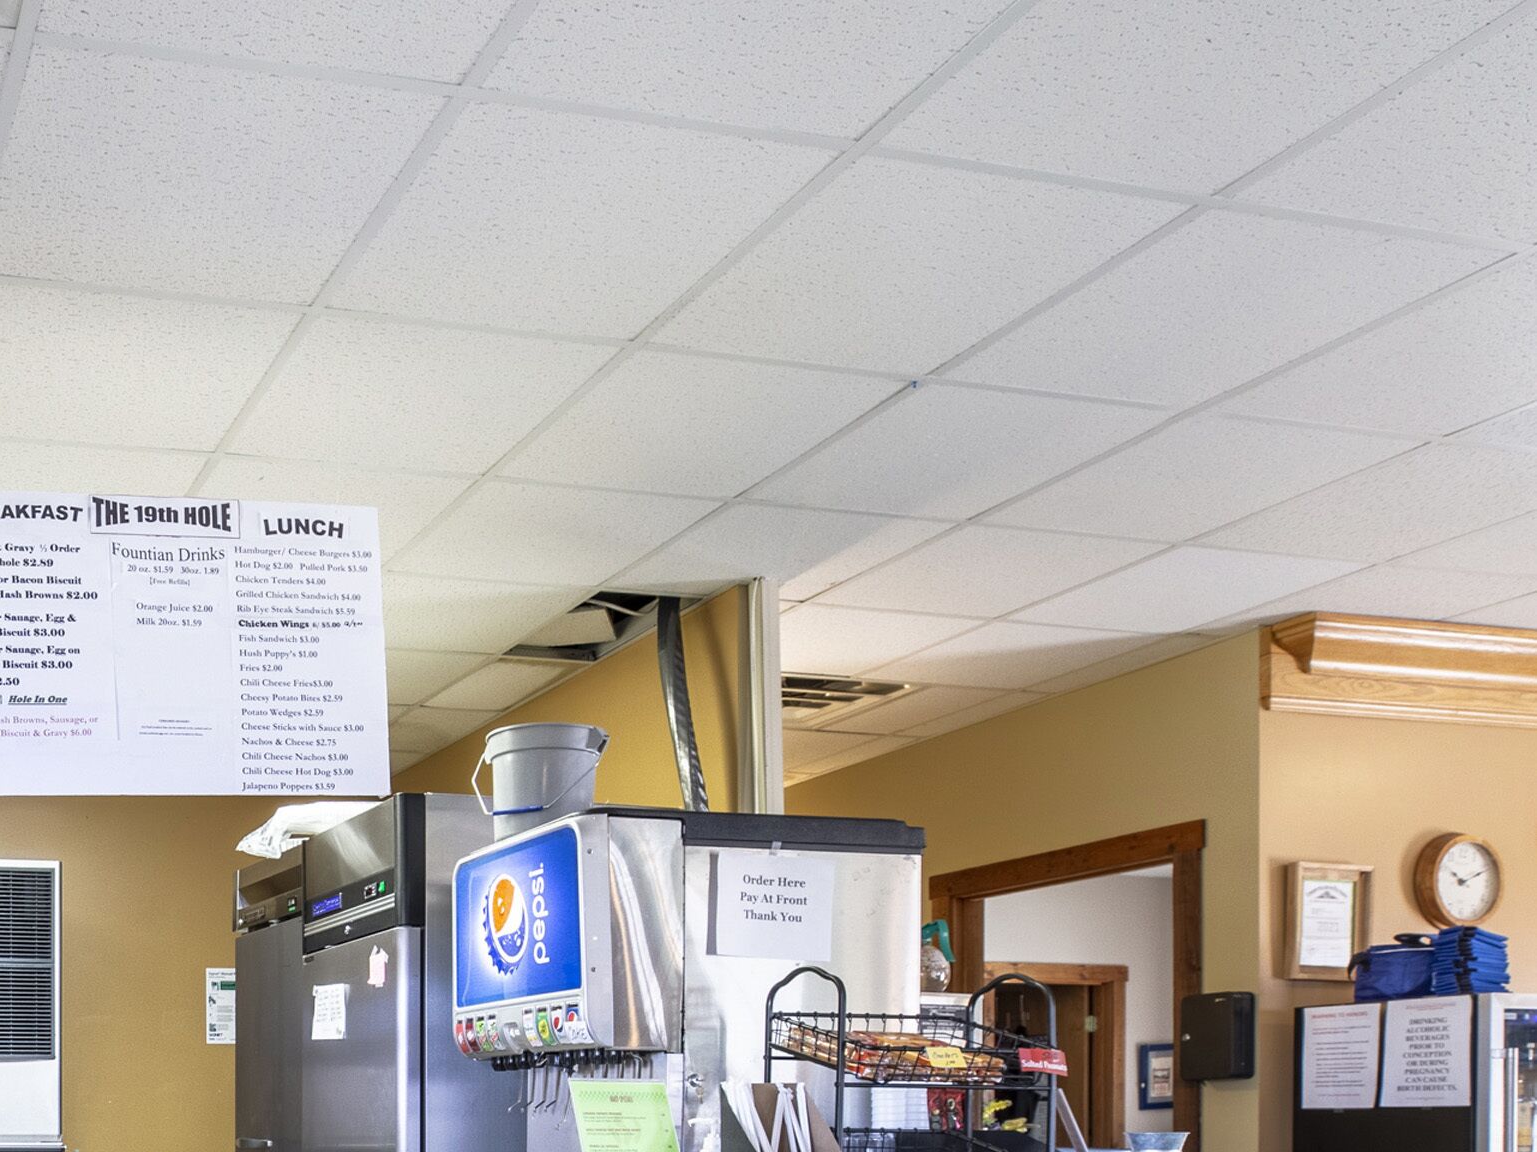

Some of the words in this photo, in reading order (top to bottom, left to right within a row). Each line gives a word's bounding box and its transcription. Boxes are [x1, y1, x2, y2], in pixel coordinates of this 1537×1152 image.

[92, 496, 130, 527] THE
[134, 505, 179, 523] 19th
[184, 502, 231, 532] HOLE
[263, 518, 344, 539] LUNCH
[5, 543, 34, 553] Gravy
[50, 544, 80, 553] Order
[112, 542, 174, 561] Fountian
[179, 547, 225, 561] Drinks
[23, 558, 53, 567] $2.89
[127, 564, 137, 572] 20
[153, 565, 173, 573] $1.59
[12, 575, 43, 584] Bacon
[46, 576, 81, 585] Biscuit
[25, 590, 63, 599] Browns
[66, 591, 98, 599] $2.00
[136, 602, 166, 612] Orange
[169, 603, 190, 612] Juice
[192, 604, 213, 613] $2.00
[4, 613, 43, 623] Sauage,
[46, 614, 65, 623] Egg
[67, 614, 76, 622] &
[136, 617, 155, 625] Milk
[158, 618, 179, 626] 20oz.
[182, 619, 202, 627] $1.59
[238, 620, 278, 628] Chicken
[280, 621, 309, 629] Wings
[33, 628, 65, 637] $3.00
[5, 646, 44, 655] Sauage,
[47, 646, 66, 655] Egg
[239, 649, 262, 657] Hush
[264, 650, 296, 659] Puppy's
[3, 660, 38, 669] Biscuit
[41, 661, 72, 669] $3.00
[8, 696, 31, 705] Hole
[34, 696, 45, 705] In
[48, 696, 68, 705] One
[270, 709, 301, 718] Wedges
[241, 723, 270, 731] Cheese
[273, 723, 297, 731] Sticks
[299, 724, 316, 732] with
[318, 724, 341, 732] Sauce
[344, 724, 364, 732] $3.00
[242, 737, 273, 746] Nachos
[285, 738, 314, 746] Cheese
[316, 739, 336, 747] $2.75
[242, 752, 262, 760] Chili
[264, 752, 293, 761] Cheese
[296, 753, 326, 761] Nachos
[242, 767, 262, 775] Chili
[264, 767, 293, 775] Cheese
[314, 768, 331, 777] Dog
[333, 768, 353, 776] $3.00
[242, 782, 278, 791] Jalapeno
[281, 783, 312, 792] Poppers
[743, 874, 775, 886] Order
[778, 877, 806, 888] Here
[740, 892, 759, 904] Pay
[761, 894, 773, 903] At
[776, 895, 807, 905] Front
[529, 862, 550, 965] pepsi
[744, 909, 778, 921] Thank
[781, 912, 802, 923] You
